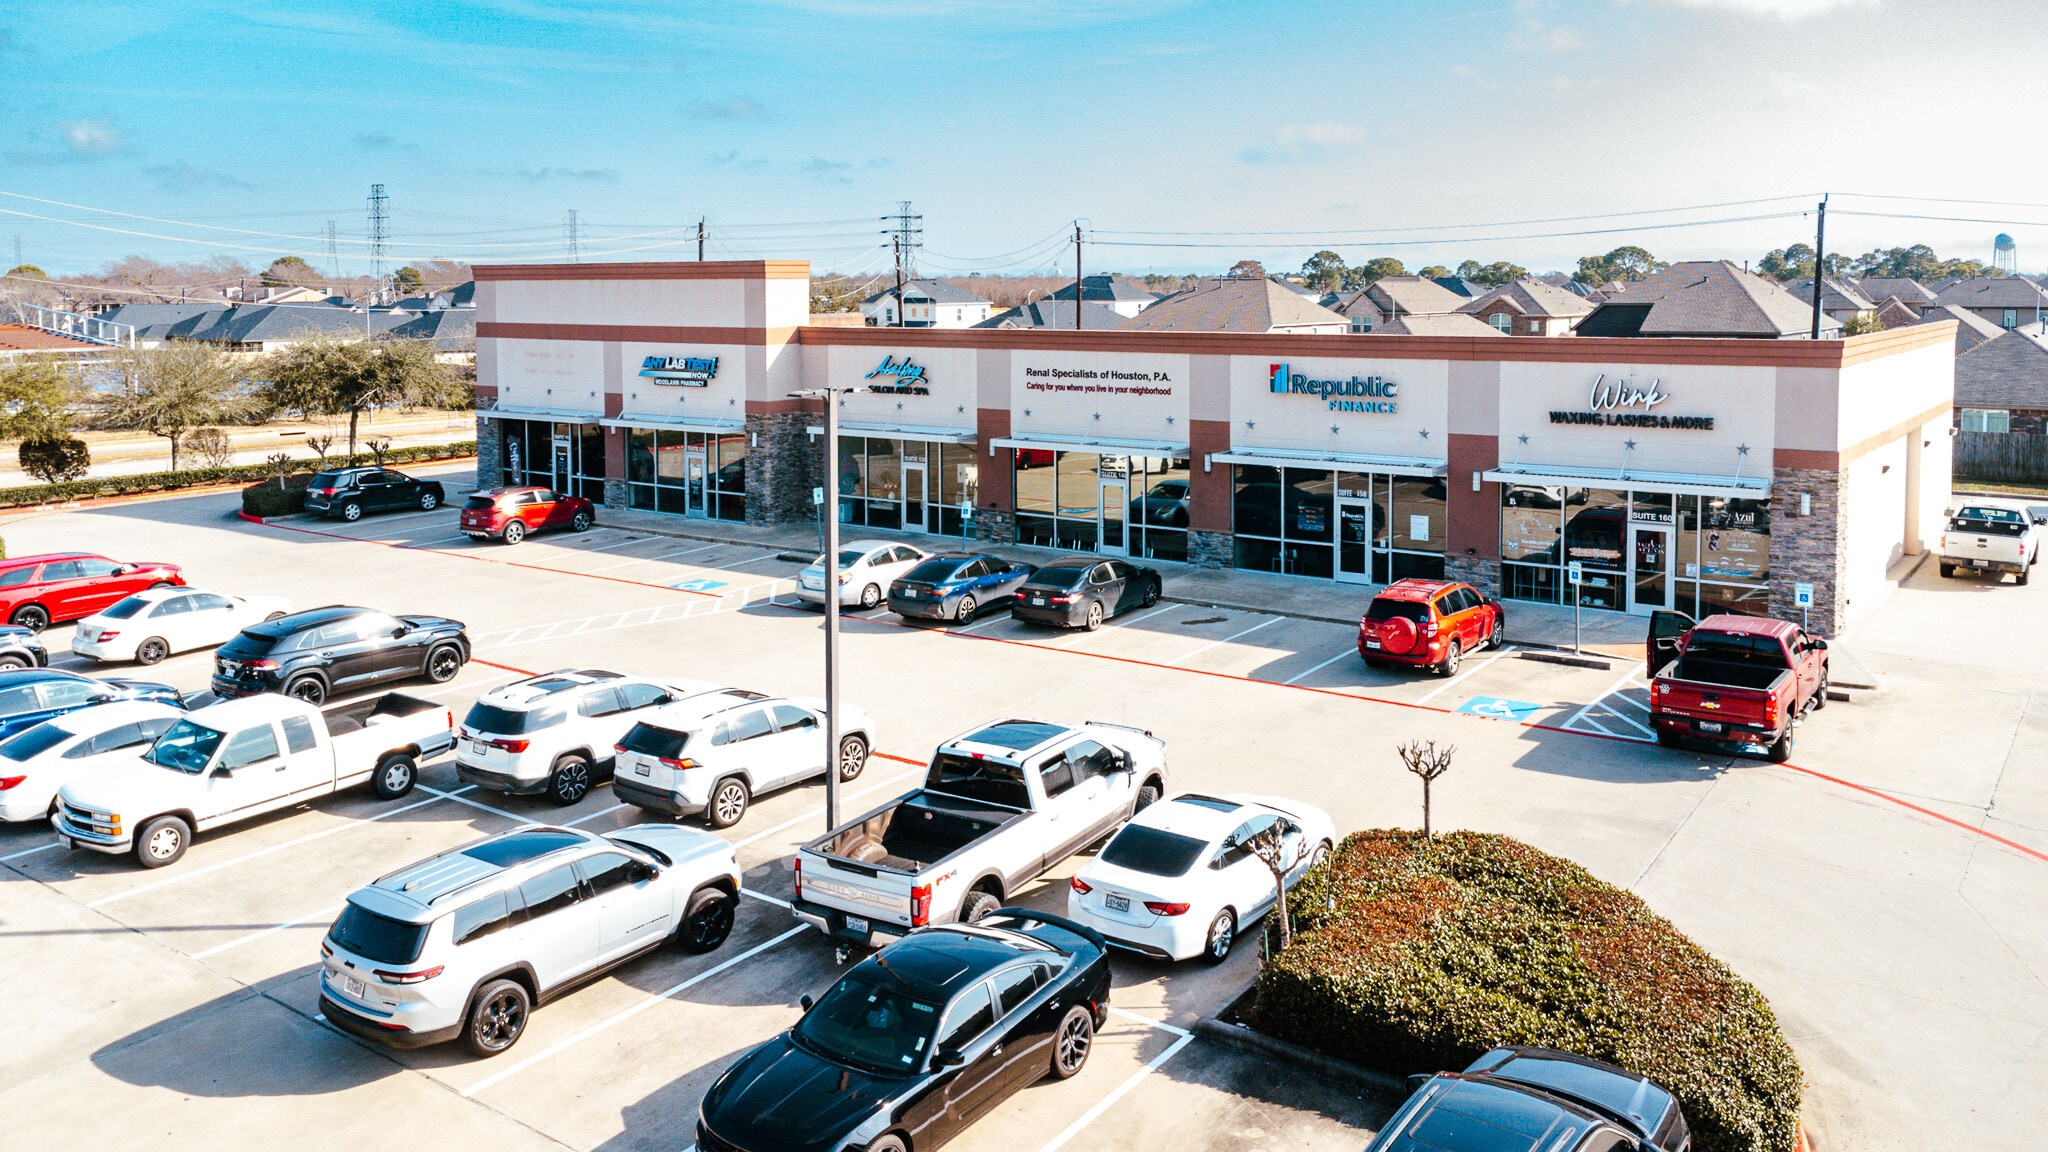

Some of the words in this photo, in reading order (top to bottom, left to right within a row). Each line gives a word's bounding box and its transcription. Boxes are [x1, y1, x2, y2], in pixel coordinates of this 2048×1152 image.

[642, 356, 664, 368] ANY
[665, 357, 686, 369] LAB
[1026, 368, 1050, 377] Renal
[1051, 369, 1098, 379] Specialists
[1100, 371, 1110, 379] of
[1111, 371, 1151, 382] Houston,
[1153, 372, 1171, 381] P.A.
[868, 385, 895, 394] SALON
[895, 386, 913, 395] AND
[913, 387, 930, 396] SPA
[1026, 382, 1045, 391] Caring
[1046, 382, 1054, 390] for
[1055, 384, 1066, 392] you
[1067, 383, 1084, 391] where
[1084, 385, 1096, 393] you
[1096, 384, 1107, 392] live
[1107, 385, 1114, 393] in
[1114, 386, 1128, 394] your
[1129, 386, 1171, 396] neighborhood
[1291, 374, 1397, 400] Republic
[1590, 374, 1669, 412] Wink
[1328, 401, 1397, 414] FINANCE
[1605, 413, 1659, 428] LASHES
[1670, 416, 1714, 431] MORE
[1357, 490, 1367, 498] 150
[1632, 511, 1656, 520] SUITE
[1733, 512, 1755, 522] Azul
[936, 869, 957, 886] FX4
